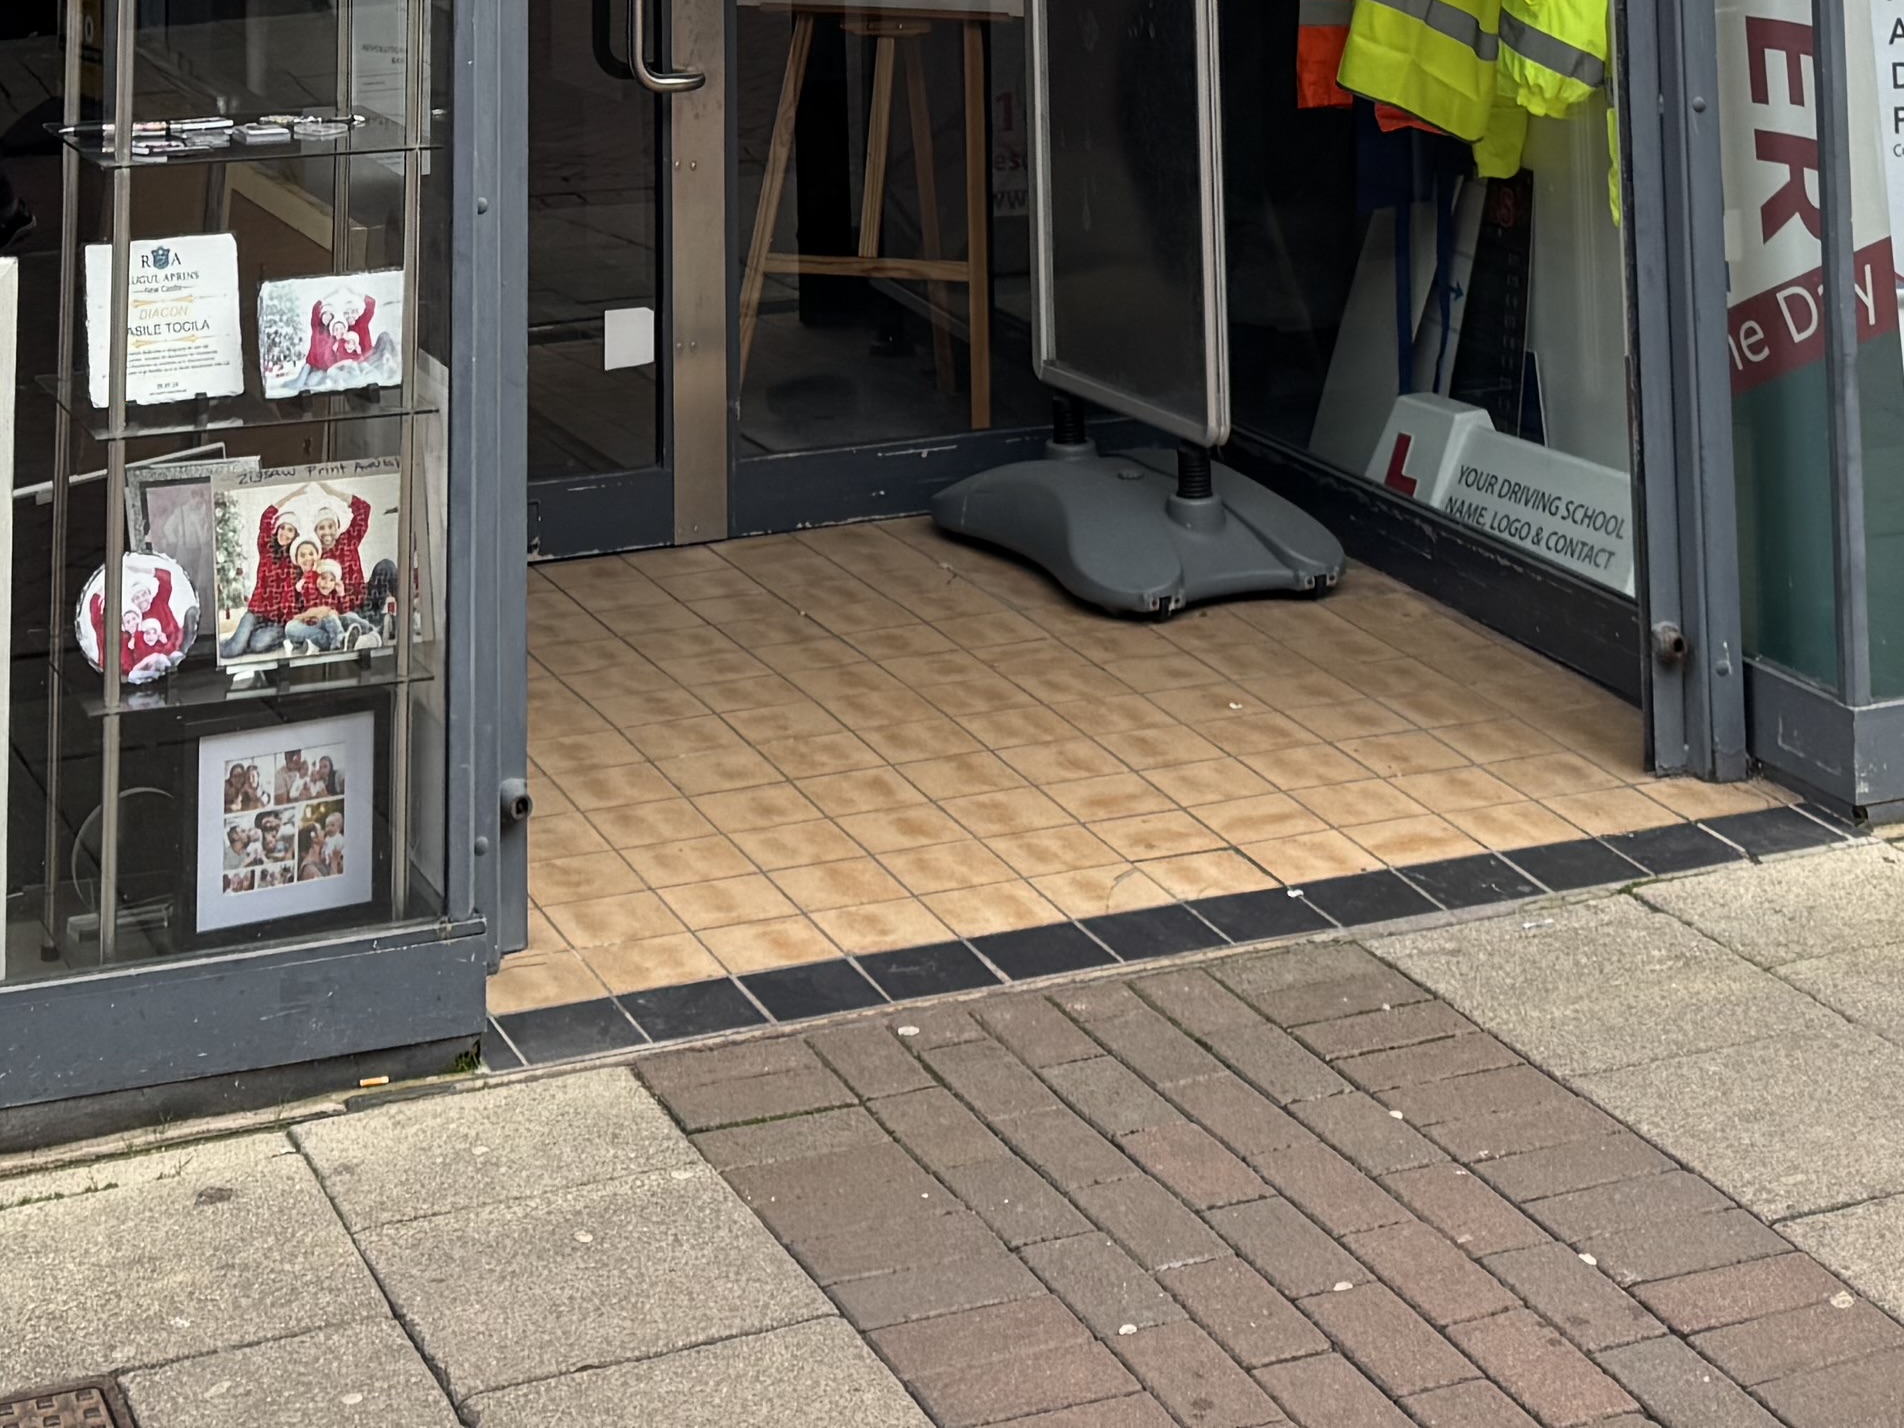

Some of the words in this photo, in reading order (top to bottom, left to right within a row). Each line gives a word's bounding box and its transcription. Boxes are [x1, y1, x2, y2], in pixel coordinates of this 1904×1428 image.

[1457, 465, 1499, 496] YOUR
[1497, 478, 1562, 518] DRIVING
[1560, 500, 1626, 541] SCHOOL
[1489, 510, 1532, 542] LOGO
[1531, 526, 1544, 547] &
[1545, 531, 1616, 571] CONTACT
